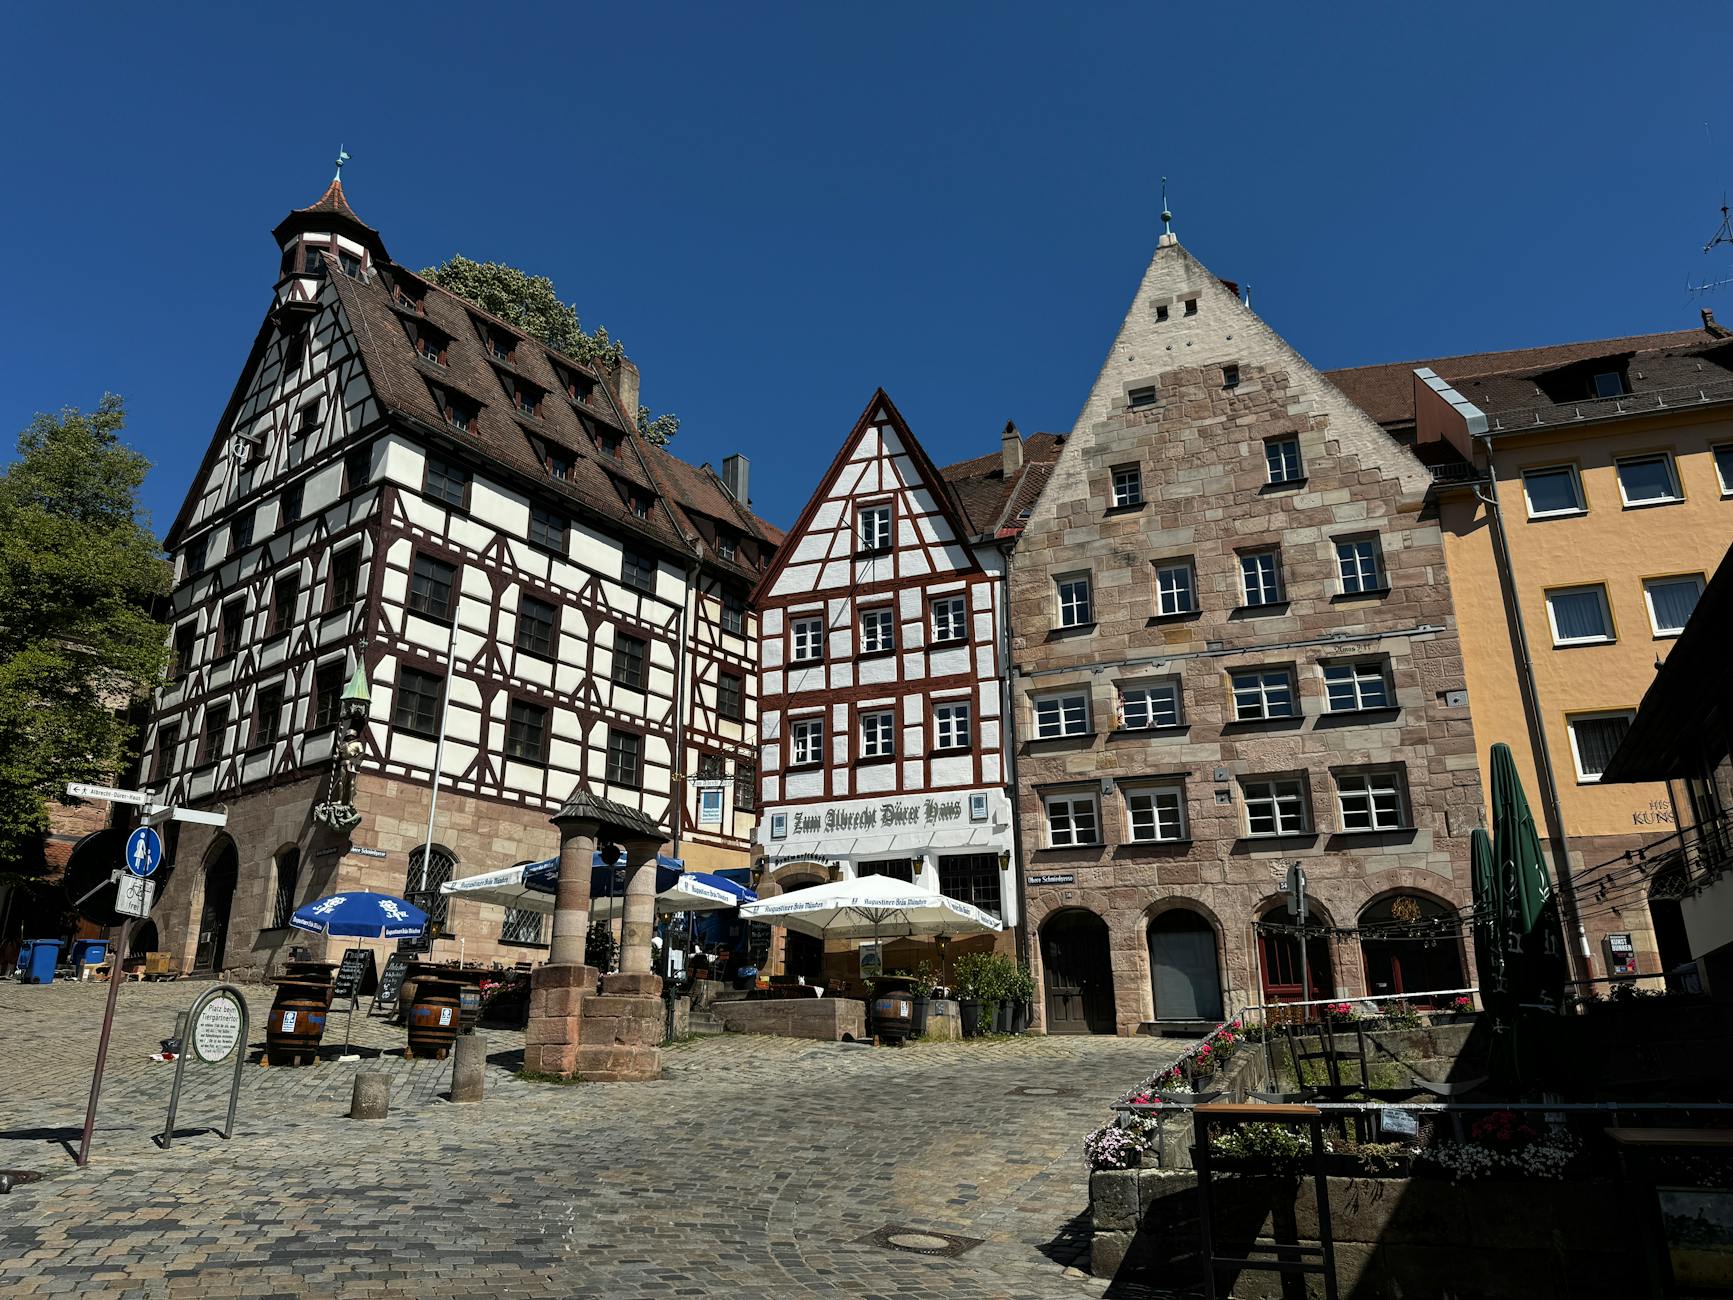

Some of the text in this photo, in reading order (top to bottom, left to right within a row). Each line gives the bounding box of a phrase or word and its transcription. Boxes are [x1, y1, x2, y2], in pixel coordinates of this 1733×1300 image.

[91, 789, 141, 801] Albrecht-Dürer-Haus
[793, 798, 962, 835] Zum Albrecht Dürer Haus
[1027, 874, 1073, 884] Obere Schmiedgasse
[128, 901, 140, 911] frei
[764, 901, 823, 913] Augustiner Bräu München
[864, 898, 927, 906] Augustiner Bräu München
[208, 1004, 222, 1012] Platz
